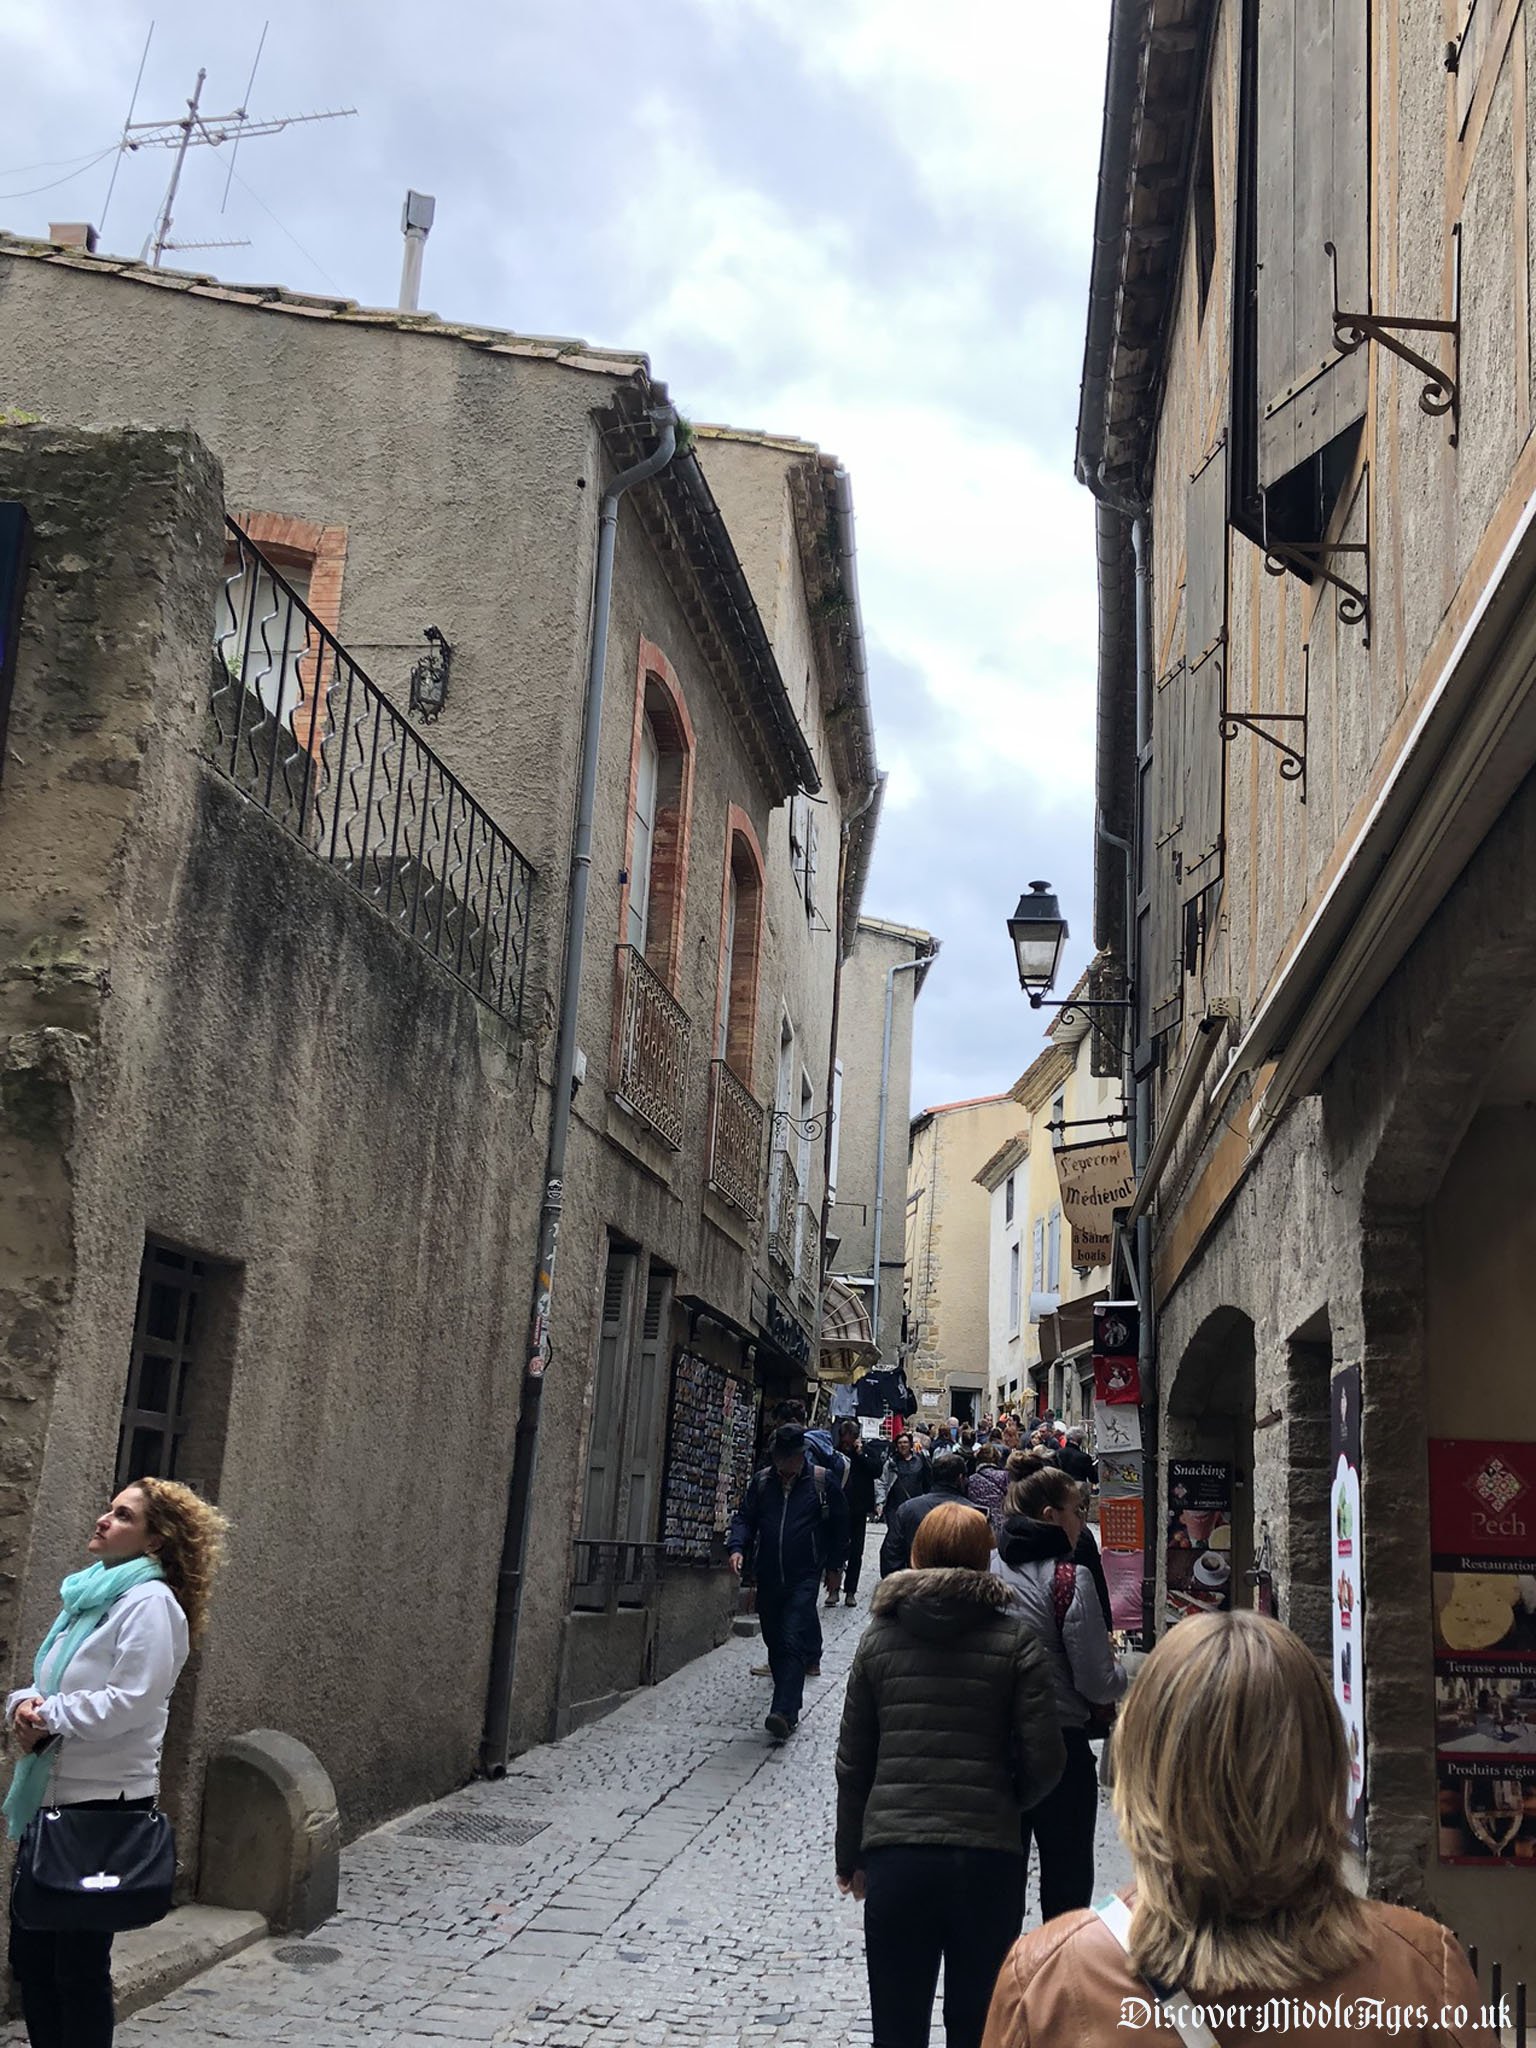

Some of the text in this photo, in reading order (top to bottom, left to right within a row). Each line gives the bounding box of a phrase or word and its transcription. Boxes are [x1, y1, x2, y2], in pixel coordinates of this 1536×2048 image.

[1065, 1179, 1132, 1206] Médiéval
[1173, 1464, 1226, 1479] Snacking
[1472, 1512, 1527, 1536] Pech
[1445, 1660, 1496, 1673] Terrasse
[1447, 1762, 1500, 1776] Produits
